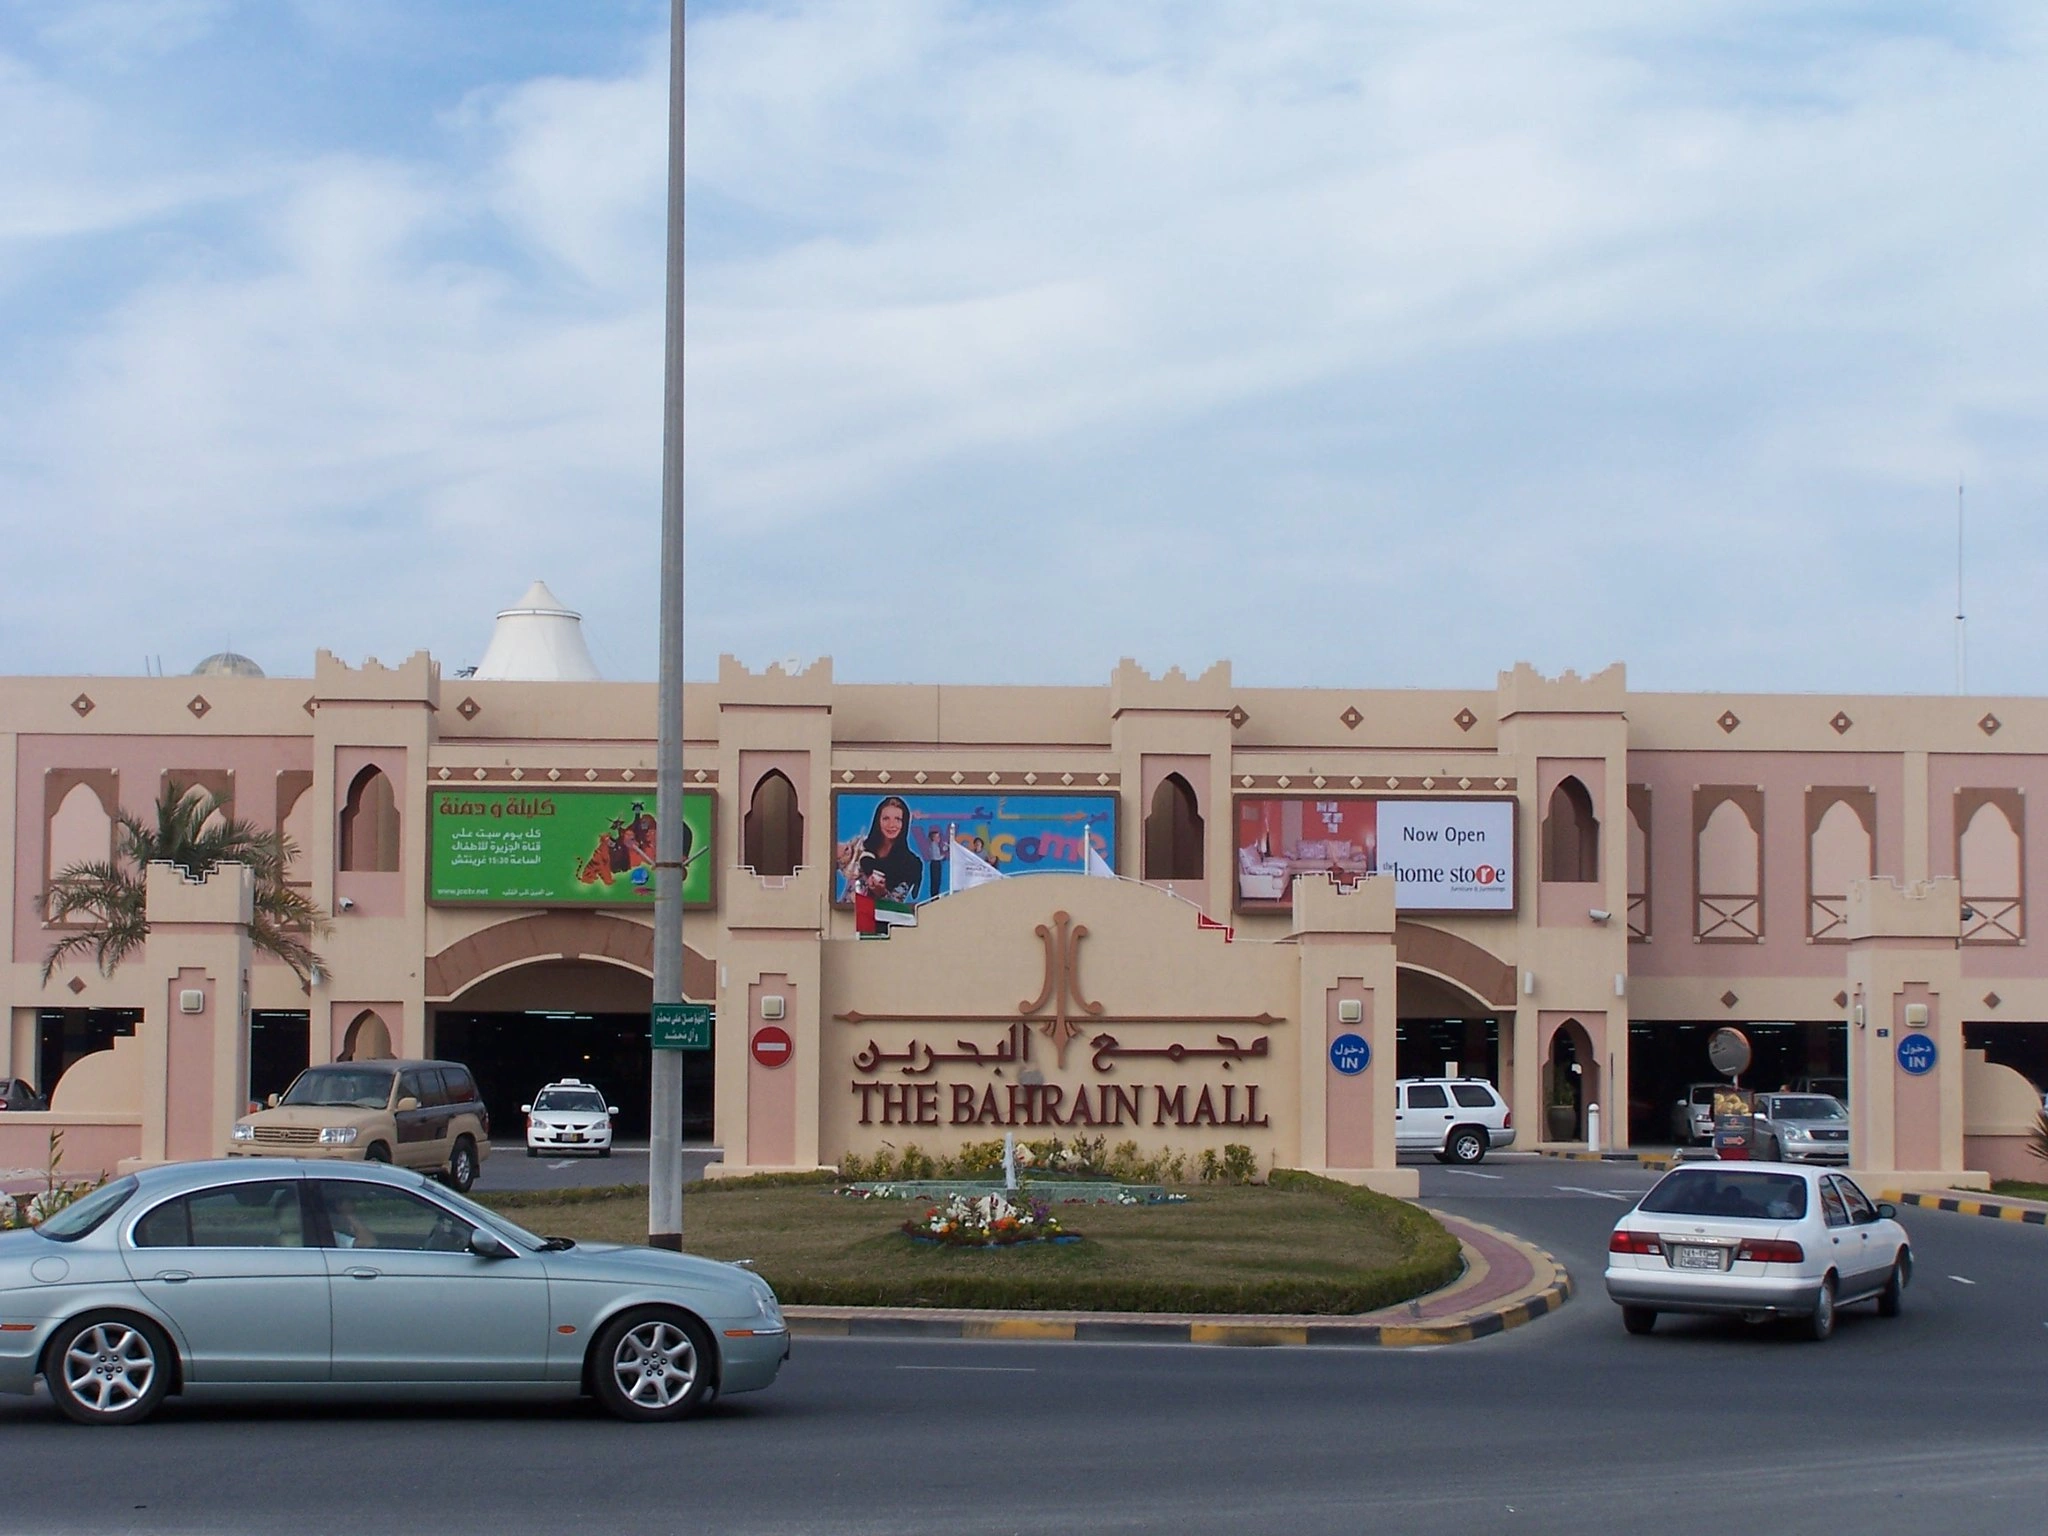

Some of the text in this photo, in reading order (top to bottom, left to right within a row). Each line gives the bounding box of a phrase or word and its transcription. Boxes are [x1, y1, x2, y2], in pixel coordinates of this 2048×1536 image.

[440, 796, 556, 818] كليلة و دمنة
[475, 829, 500, 838] سبت
[503, 832, 522, 840] يوم
[525, 827, 541, 838] كل
[1403, 826, 1485, 846] Now Open
[490, 841, 520, 854] الجزيرة
[521, 841, 541, 851] قناة
[910, 822, 1108, 863] Welcome
[451, 854, 486, 867] غرينتش
[510, 855, 541, 864] الساعة
[1383, 862, 1505, 885] the home store
[853, 1023, 1269, 1077] مجمع البحرين
[1335, 1043, 1365, 1055] دخول
[1901, 1043, 1932, 1055] دخول
[1341, 1057, 1358, 1069] IN
[1908, 1057, 1926, 1068] IN
[851, 1080, 1269, 1128] THE BAHRAIN MALL
